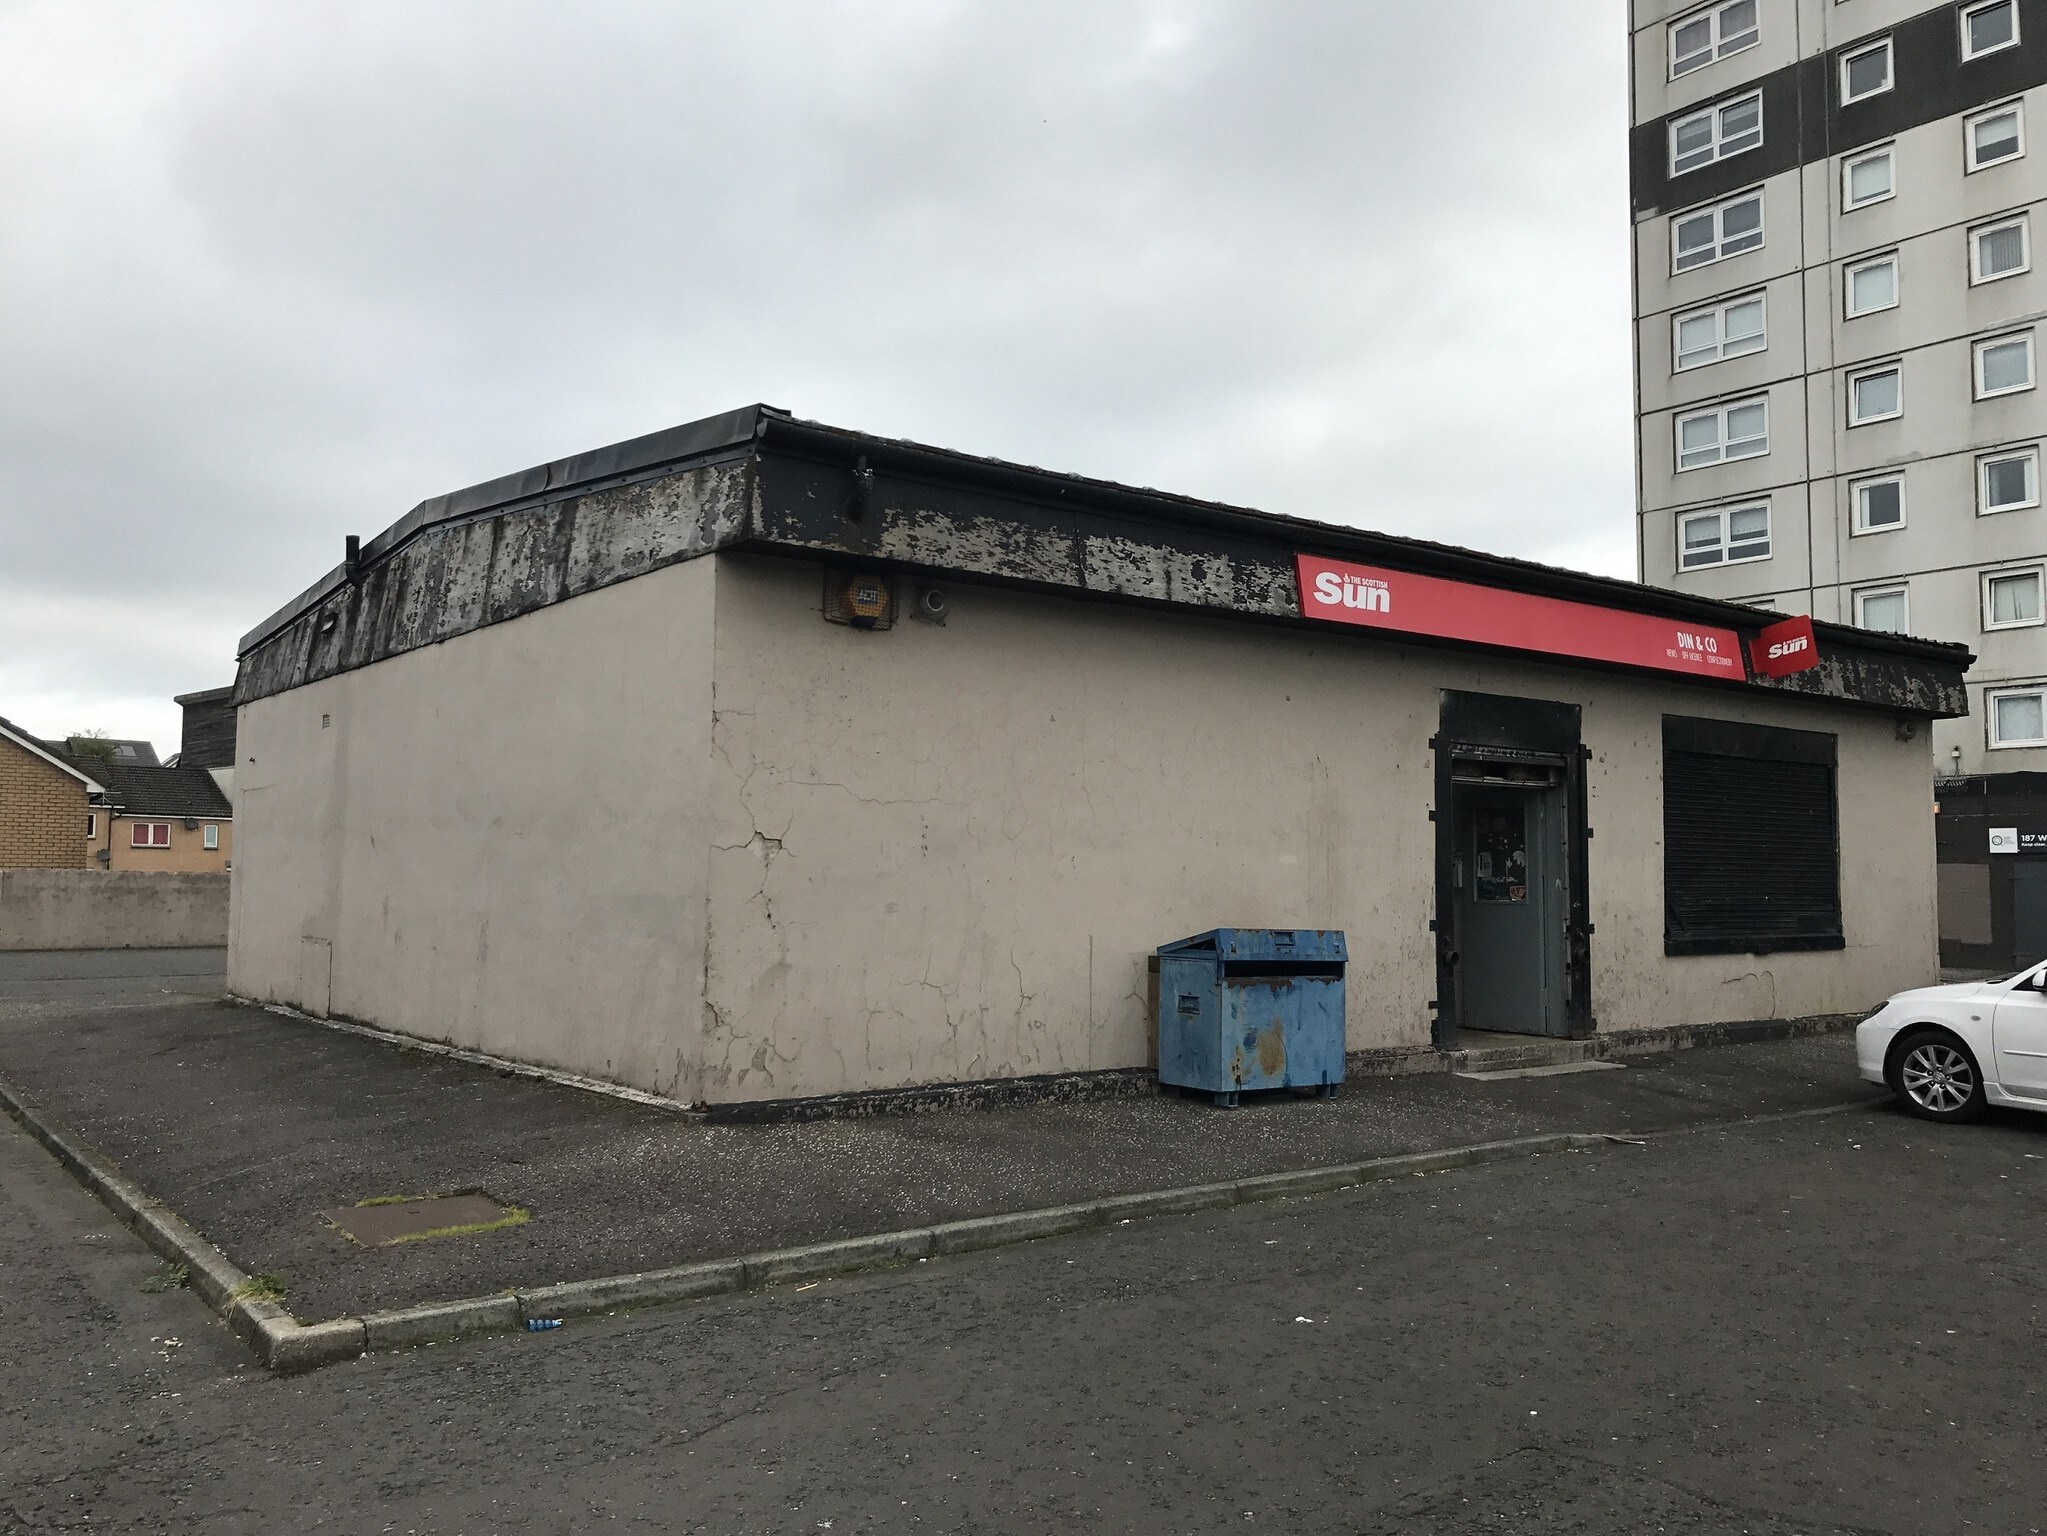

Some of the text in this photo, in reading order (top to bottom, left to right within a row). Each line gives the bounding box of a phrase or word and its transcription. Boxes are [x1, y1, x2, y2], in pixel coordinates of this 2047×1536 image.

[1350, 576, 1388, 589] THE SCOTTISH
[1313, 571, 1390, 613] Sun
[1676, 631, 1718, 653] DIN & CO
[1767, 639, 1808, 659] Sun
[1666, 648, 1678, 658] NEWS
[2021, 834, 2036, 842] 187
